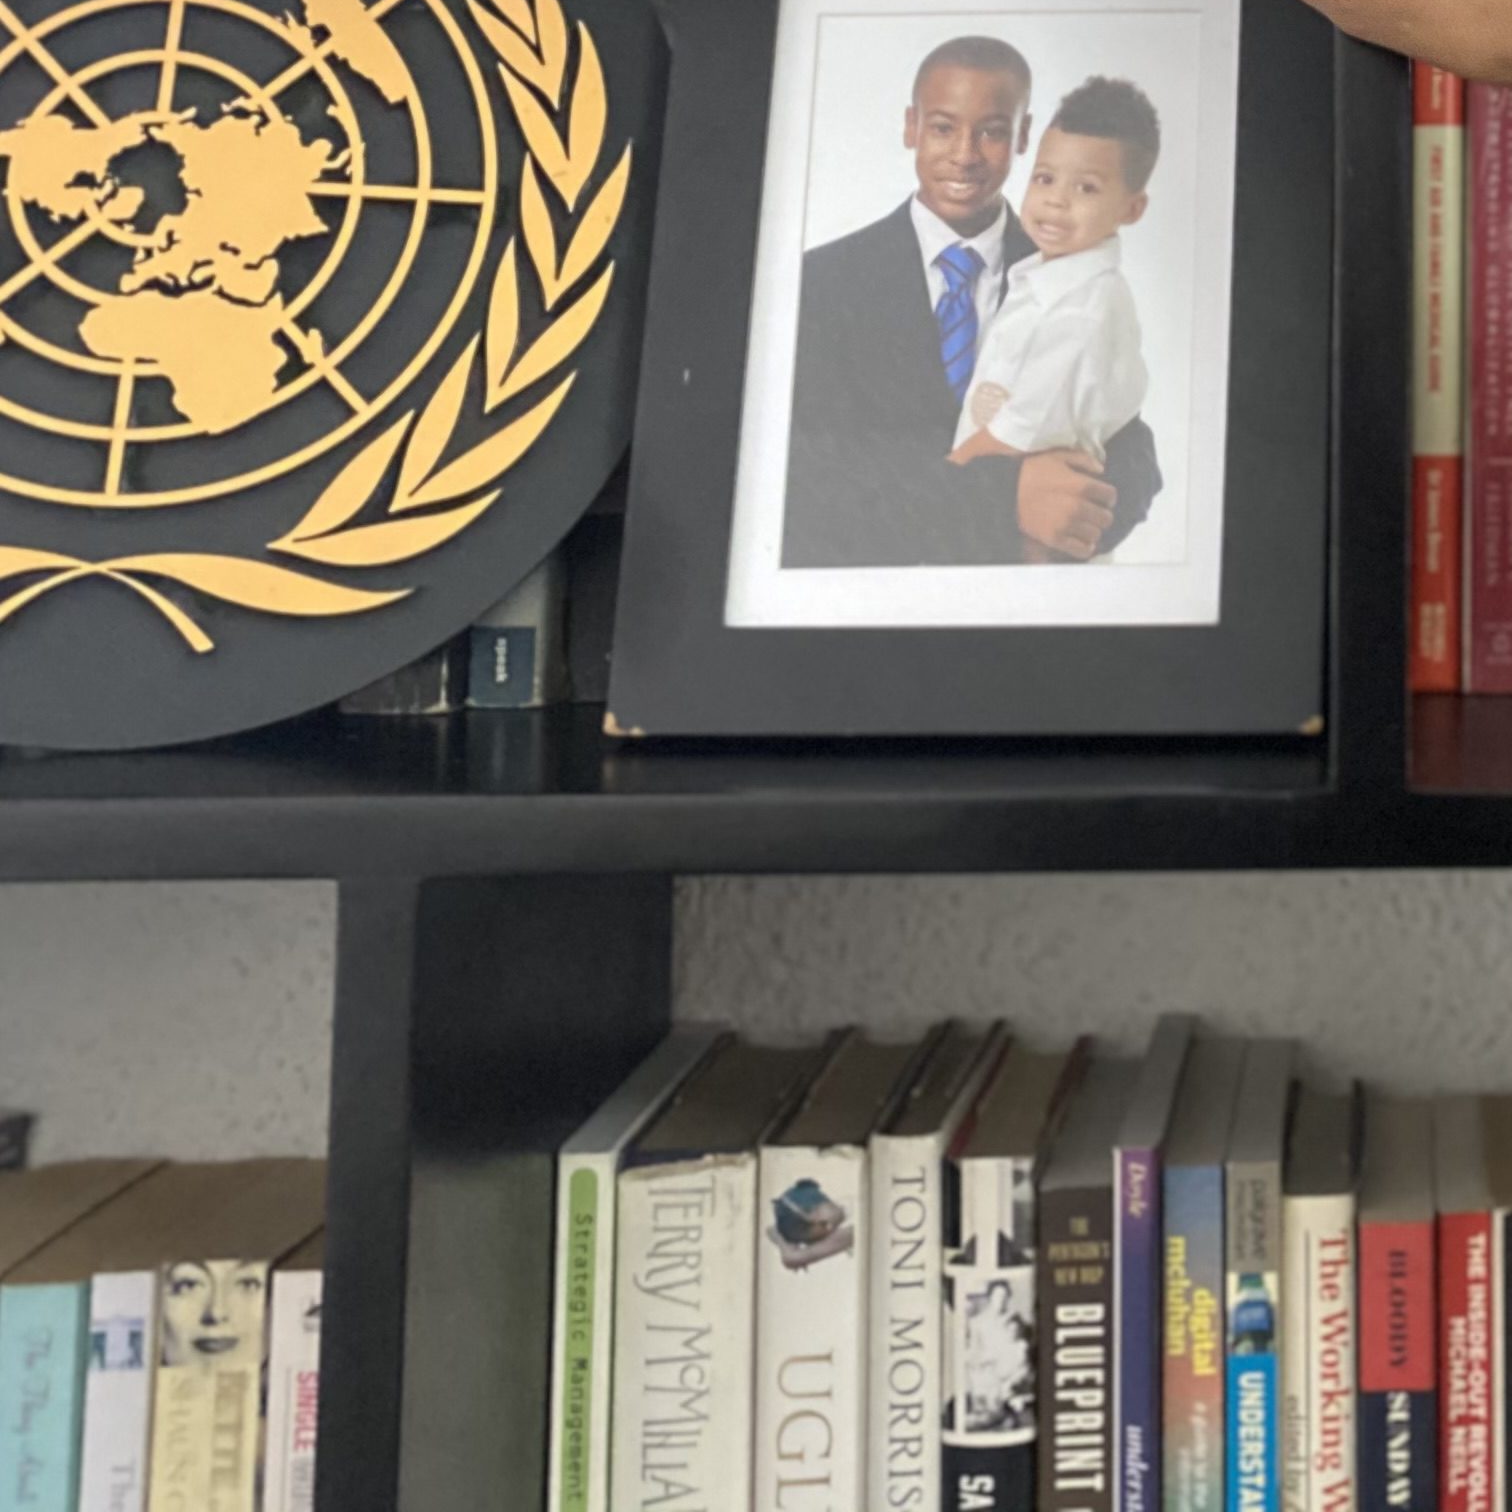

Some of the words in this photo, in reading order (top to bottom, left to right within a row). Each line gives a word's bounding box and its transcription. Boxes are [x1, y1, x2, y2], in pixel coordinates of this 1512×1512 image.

[568, 1212, 593, 1342] Strategic
[633, 1174, 717, 1312] TERRY
[888, 1166, 928, 1292] TONI
[1318, 1228, 1352, 1302] The
[1467, 1232, 1488, 1278] THE
[1166, 1236, 1192, 1356] mcluhan
[1191, 1287, 1218, 1376] digital
[1467, 1283, 1488, 1418] INSIDE-OUT
[294, 1370, 320, 1451] SINGLE
[564, 1357, 589, 1503] Management
[641, 1321, 713, 1512] McMILLA
[775, 1350, 834, 1512] UGL
[887, 1316, 926, 1512] MORRIS
[1054, 1303, 1105, 1492] BLUEPRINT
[1314, 1308, 1352, 1471] Working
[1447, 1316, 1468, 1423] MICHAEL
[1124, 1424, 1149, 1512] underst
[1236, 1371, 1266, 1512] UNDERSTA
[1447, 1425, 1468, 1494] NEILL
